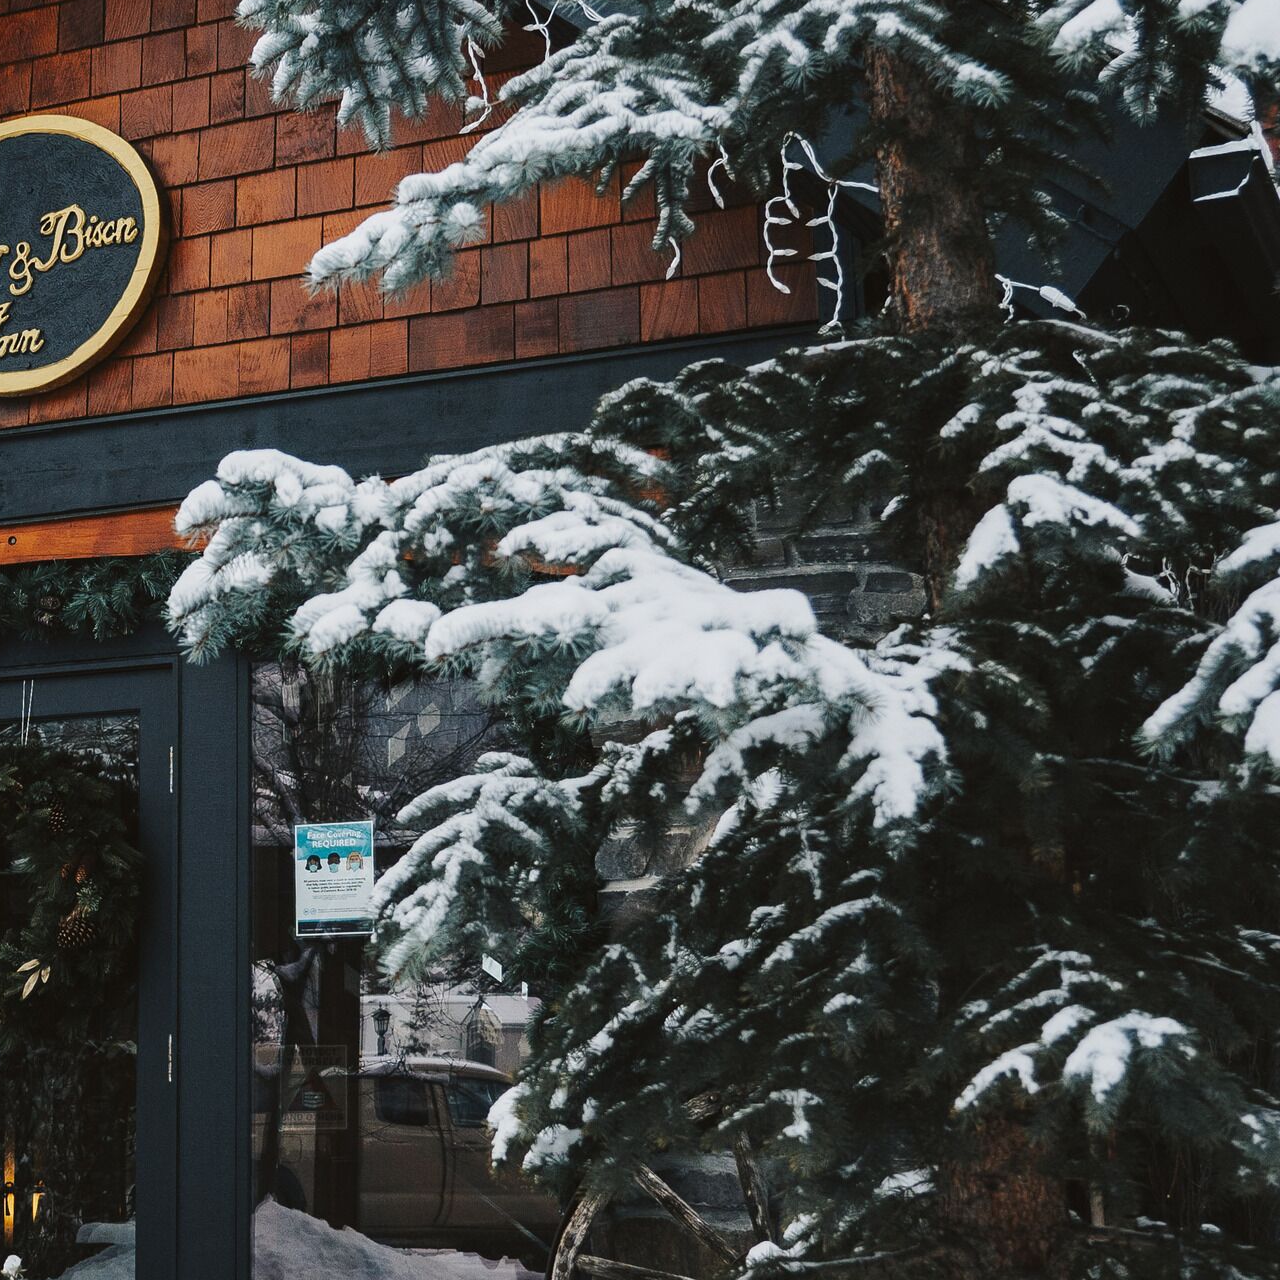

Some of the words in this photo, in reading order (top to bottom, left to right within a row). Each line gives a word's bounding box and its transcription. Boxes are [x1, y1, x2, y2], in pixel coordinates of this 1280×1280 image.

[9, 241, 36, 296] &
[35, 203, 139, 272] Bison
[306, 831, 325, 840] Face
[326, 830, 363, 839] Covering
[312, 839, 356, 848] REQUIRED
